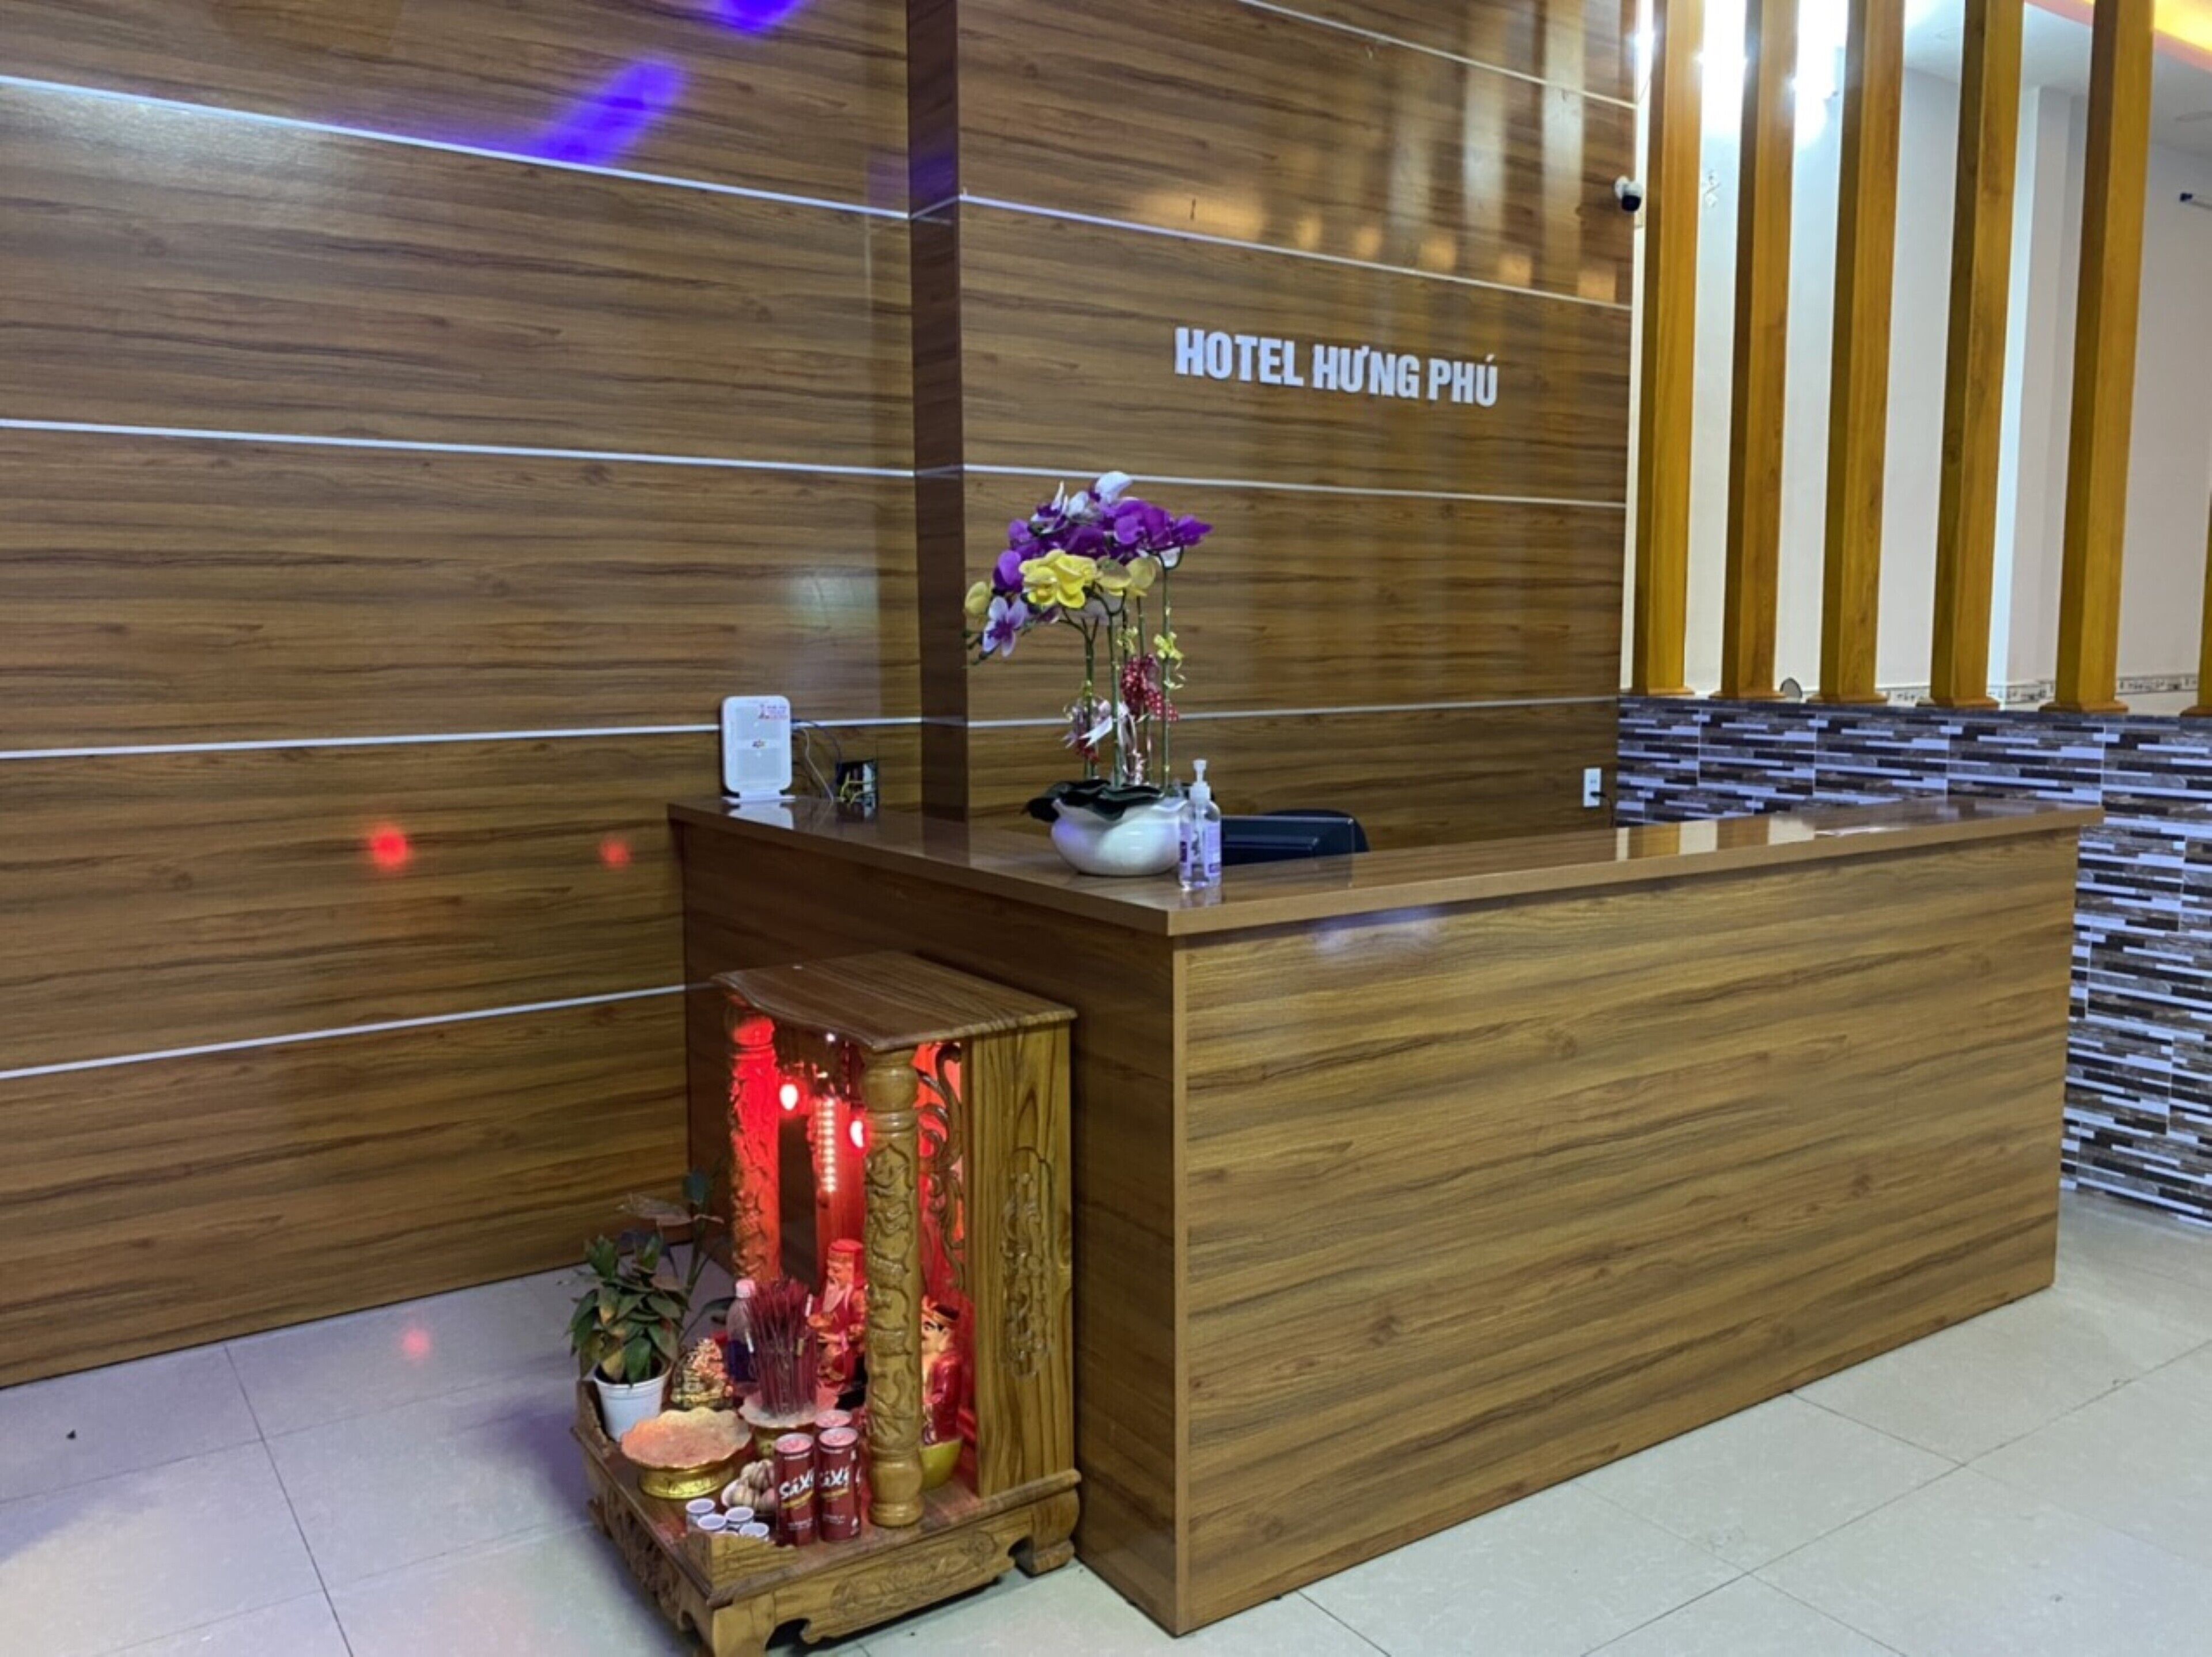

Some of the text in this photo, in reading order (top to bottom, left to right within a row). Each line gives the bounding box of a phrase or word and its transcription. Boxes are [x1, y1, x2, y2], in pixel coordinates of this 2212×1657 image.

[1175, 327, 1498, 407] HOTEL HƯNG PHÚ
